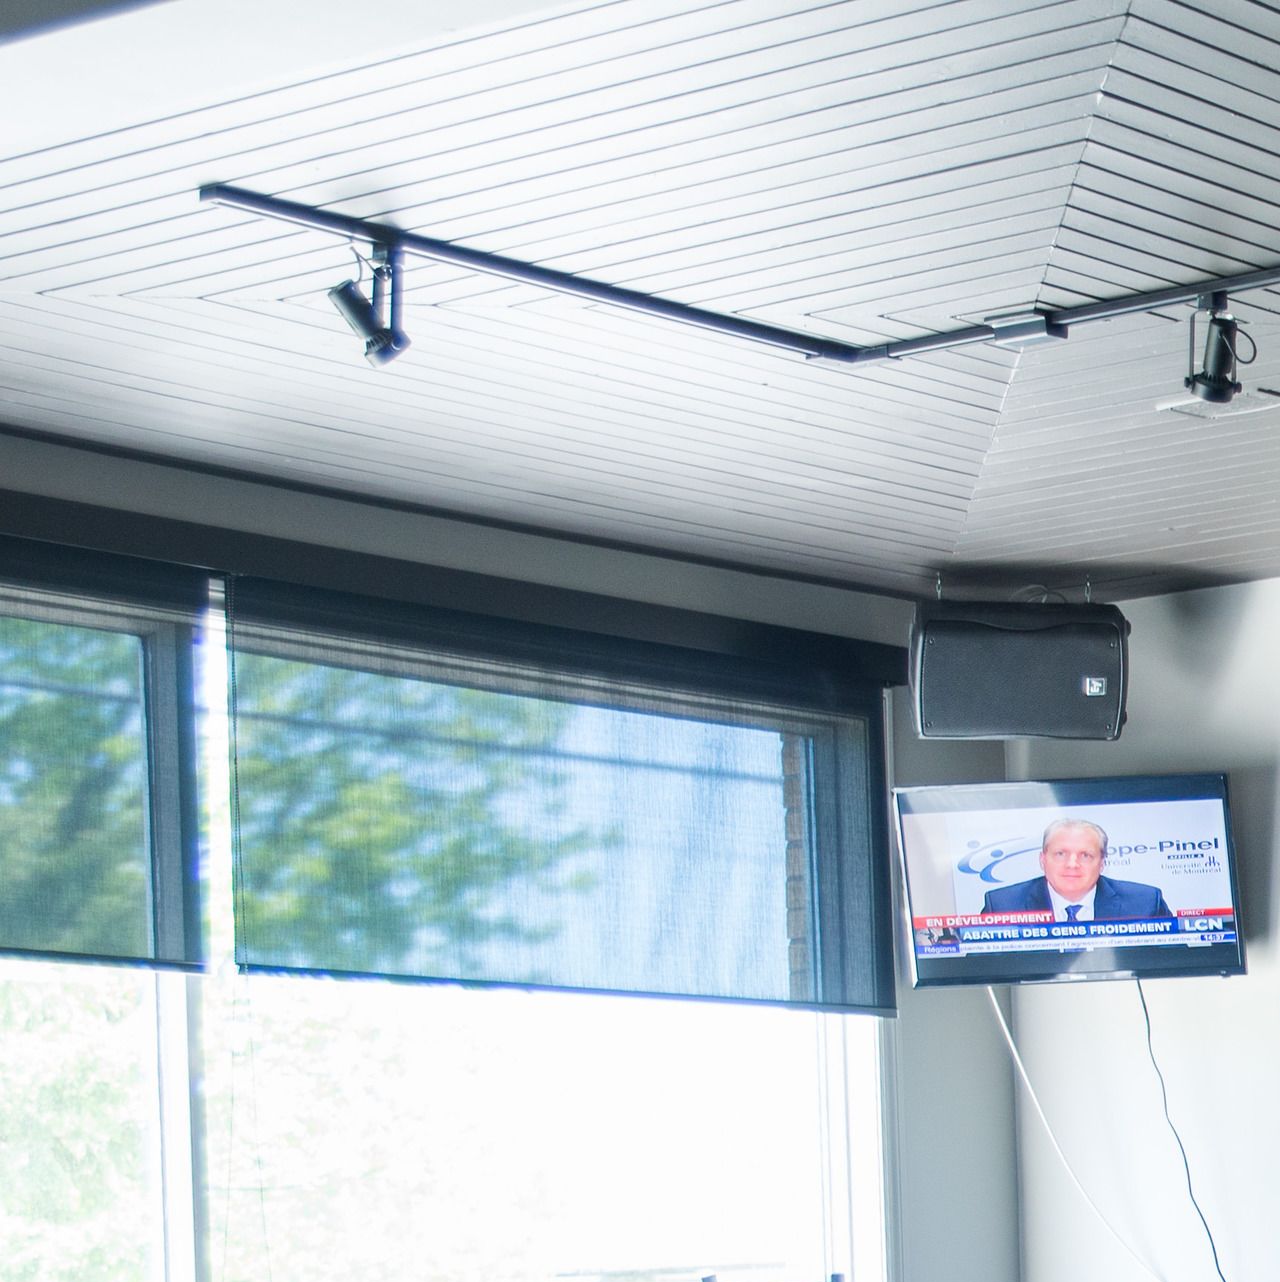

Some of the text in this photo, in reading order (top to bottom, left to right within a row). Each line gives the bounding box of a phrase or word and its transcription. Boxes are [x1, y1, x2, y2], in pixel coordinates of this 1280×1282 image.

[1105, 837, 1219, 858] ppe-Pinel
[926, 918, 943, 928] EN
[1184, 917, 1223, 931] LCN
[963, 922, 1172, 941] ABATTRE DES GENS FROIDEMENT
